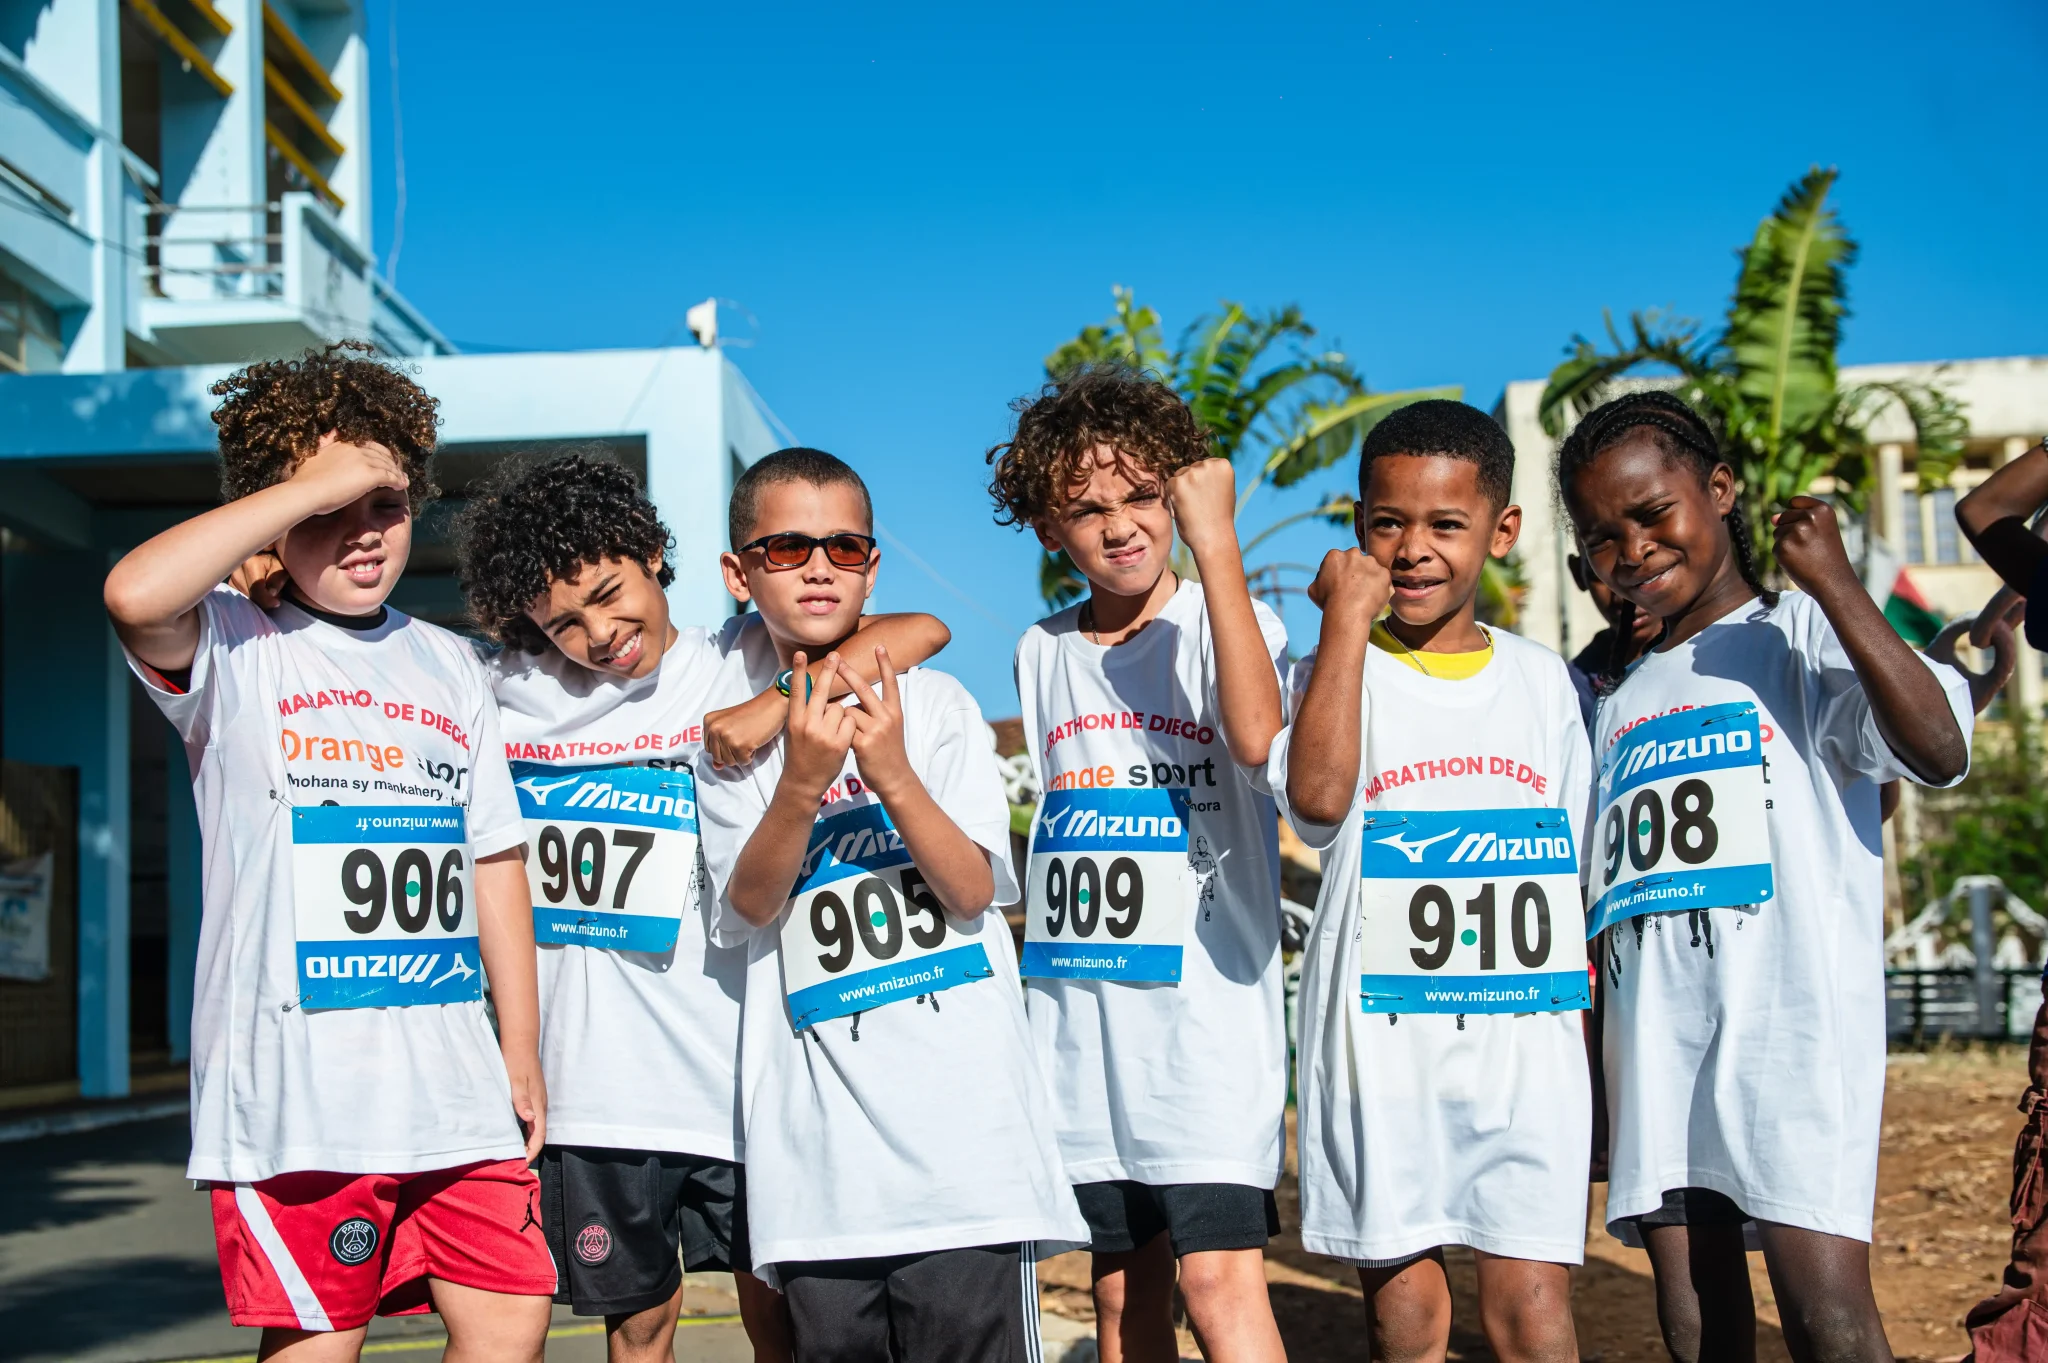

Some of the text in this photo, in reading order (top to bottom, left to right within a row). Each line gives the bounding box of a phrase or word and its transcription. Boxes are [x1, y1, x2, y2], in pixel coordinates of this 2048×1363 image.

[278, 689, 379, 717] MARATHO
[384, 702, 415, 721] DE
[504, 725, 704, 761] MARATHON DE DIE
[1045, 711, 1215, 761] RATHON DE DIEGO
[352, 778, 370, 793] sy
[374, 780, 444, 801] mankahery
[1128, 757, 1217, 789] sport
[1365, 756, 1548, 803] MARATHON DE DIE
[355, 817, 460, 831] www.mizuno.fr
[1602, 778, 1719, 887] 908
[538, 825, 656, 910] 907
[341, 848, 464, 934] 906
[1045, 856, 1144, 939] 909
[1605, 883, 1707, 916] www.mizuno.fr
[551, 922, 628, 939] www.mizuno.fr
[809, 867, 947, 974] 905
[1408, 881, 1552, 971] 910
[1051, 956, 1128, 970] www.mizuno.fr
[839, 966, 945, 1004] www.mizuno.fr
[1424, 987, 1540, 1002] www.mizuno.fr
[341, 1223, 370, 1234] PARIS
[583, 1227, 605, 1236] PARIS
